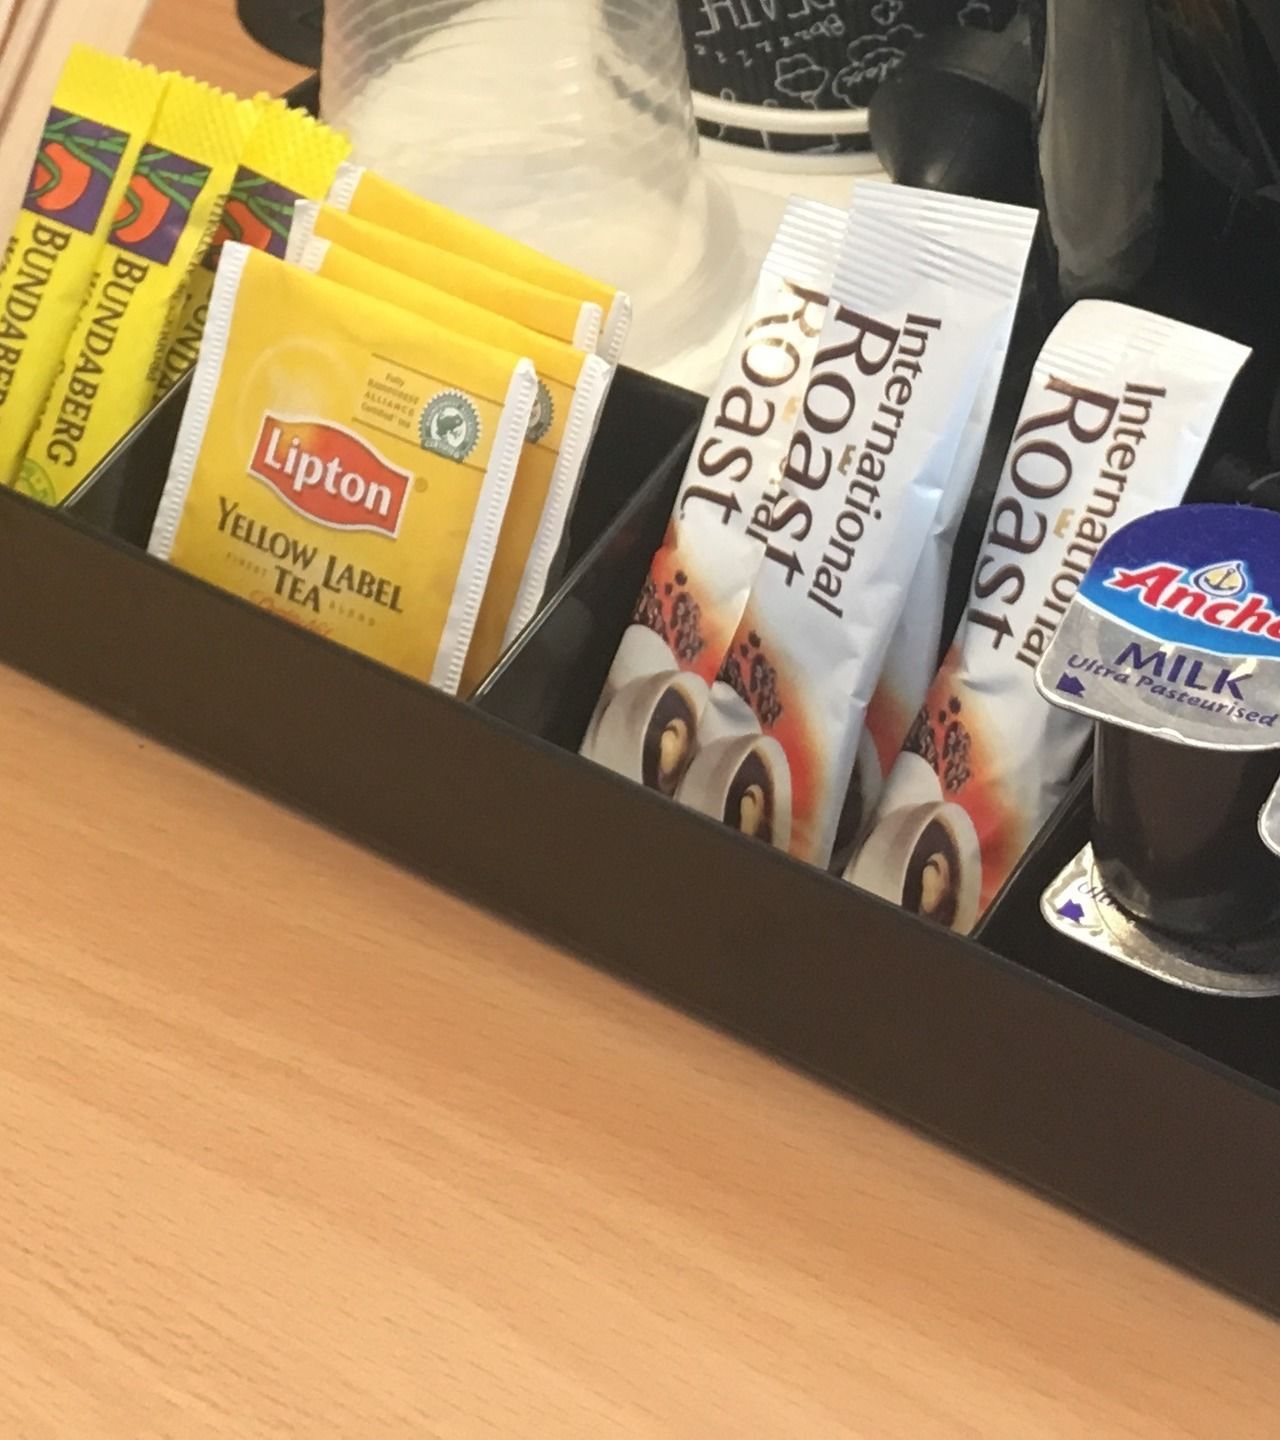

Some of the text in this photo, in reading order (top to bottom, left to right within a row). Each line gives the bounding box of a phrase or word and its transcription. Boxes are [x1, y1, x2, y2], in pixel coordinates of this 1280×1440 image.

[46, 251, 149, 468] BUNDABERG
[680, 277, 831, 526] Roast
[263, 427, 393, 517] Lipton
[767, 305, 901, 588] Roast
[807, 312, 943, 619] International
[966, 372, 1120, 651] Roast
[217, 496, 318, 571] YELLOW
[322, 555, 404, 614] LABEL
[274, 564, 321, 613] TEA
[1066, 654, 1280, 728] Ultra Pasteurised
[1112, 641, 1253, 701] MILK
